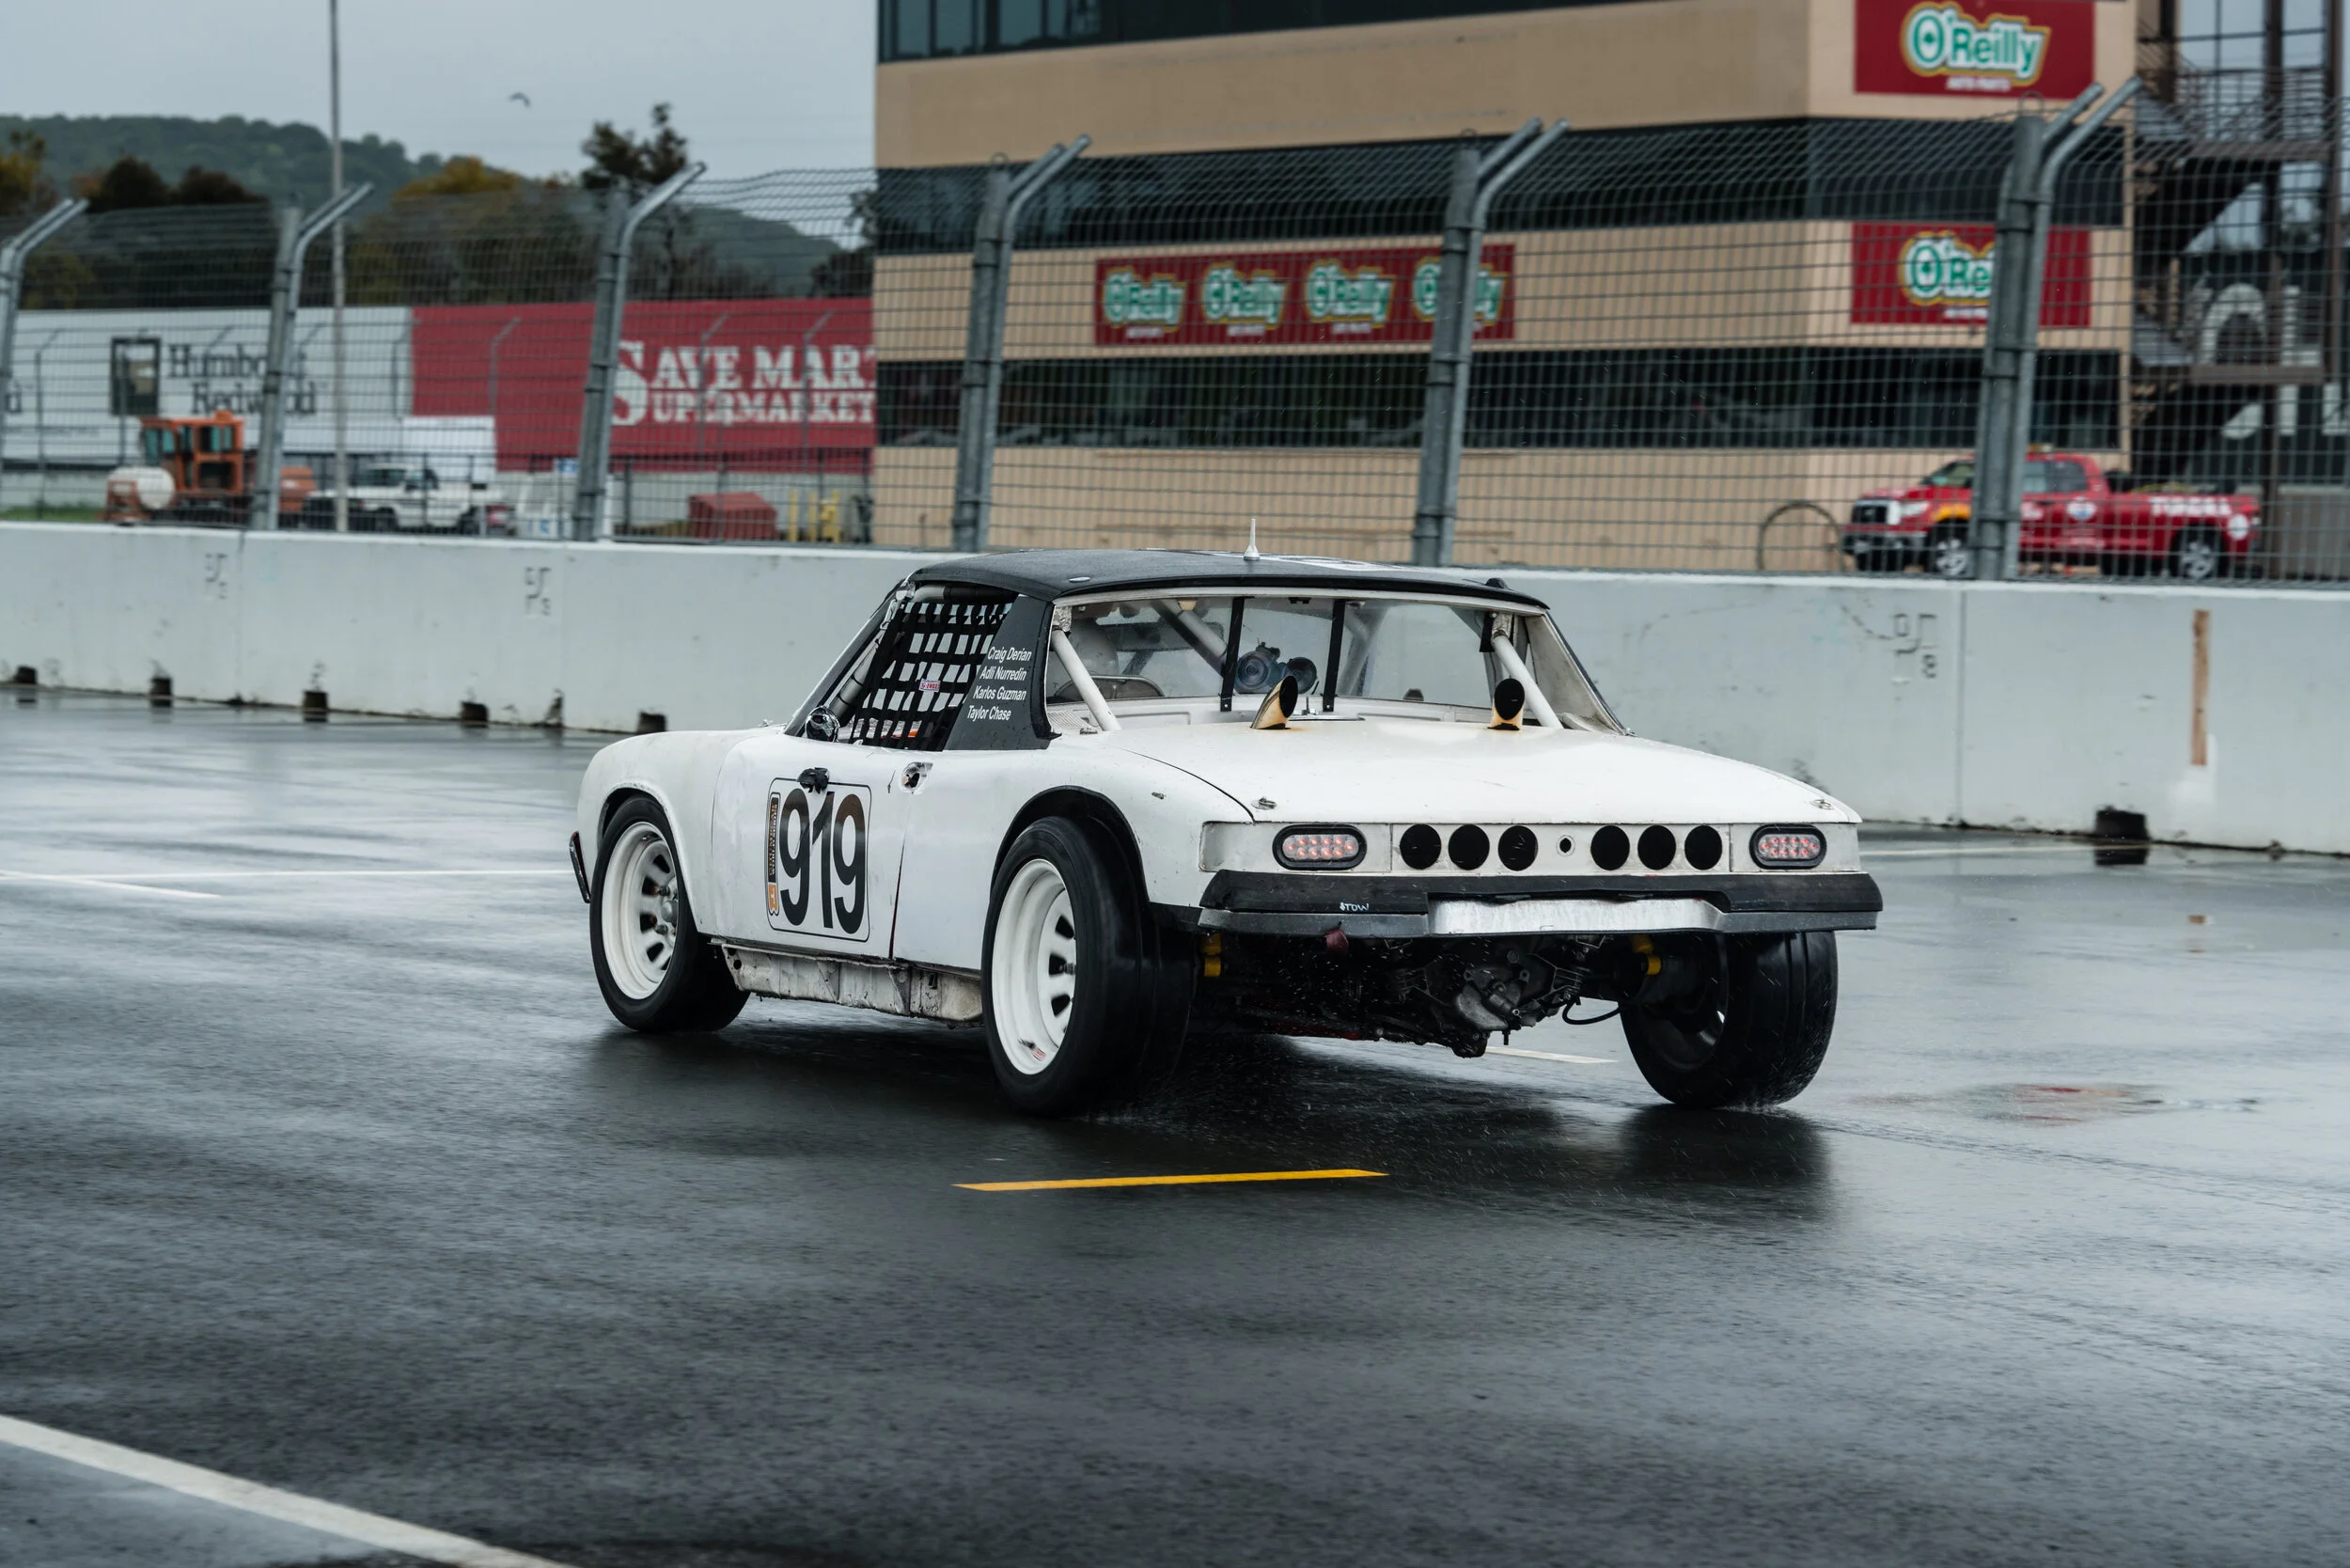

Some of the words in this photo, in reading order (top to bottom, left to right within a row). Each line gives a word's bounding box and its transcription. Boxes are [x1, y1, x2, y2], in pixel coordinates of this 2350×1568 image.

[1909, 8, 2044, 79] O'Reilly
[987, 646, 1007, 663] Craig
[1007, 647, 1032, 662] Derian
[996, 666, 1027, 681] Nurredin
[973, 685, 996, 700] Karlos
[996, 686, 1026, 700] Guzman
[967, 705, 990, 722] Taylor
[989, 706, 1011, 721] Chase
[779, 788, 866, 934] 919
